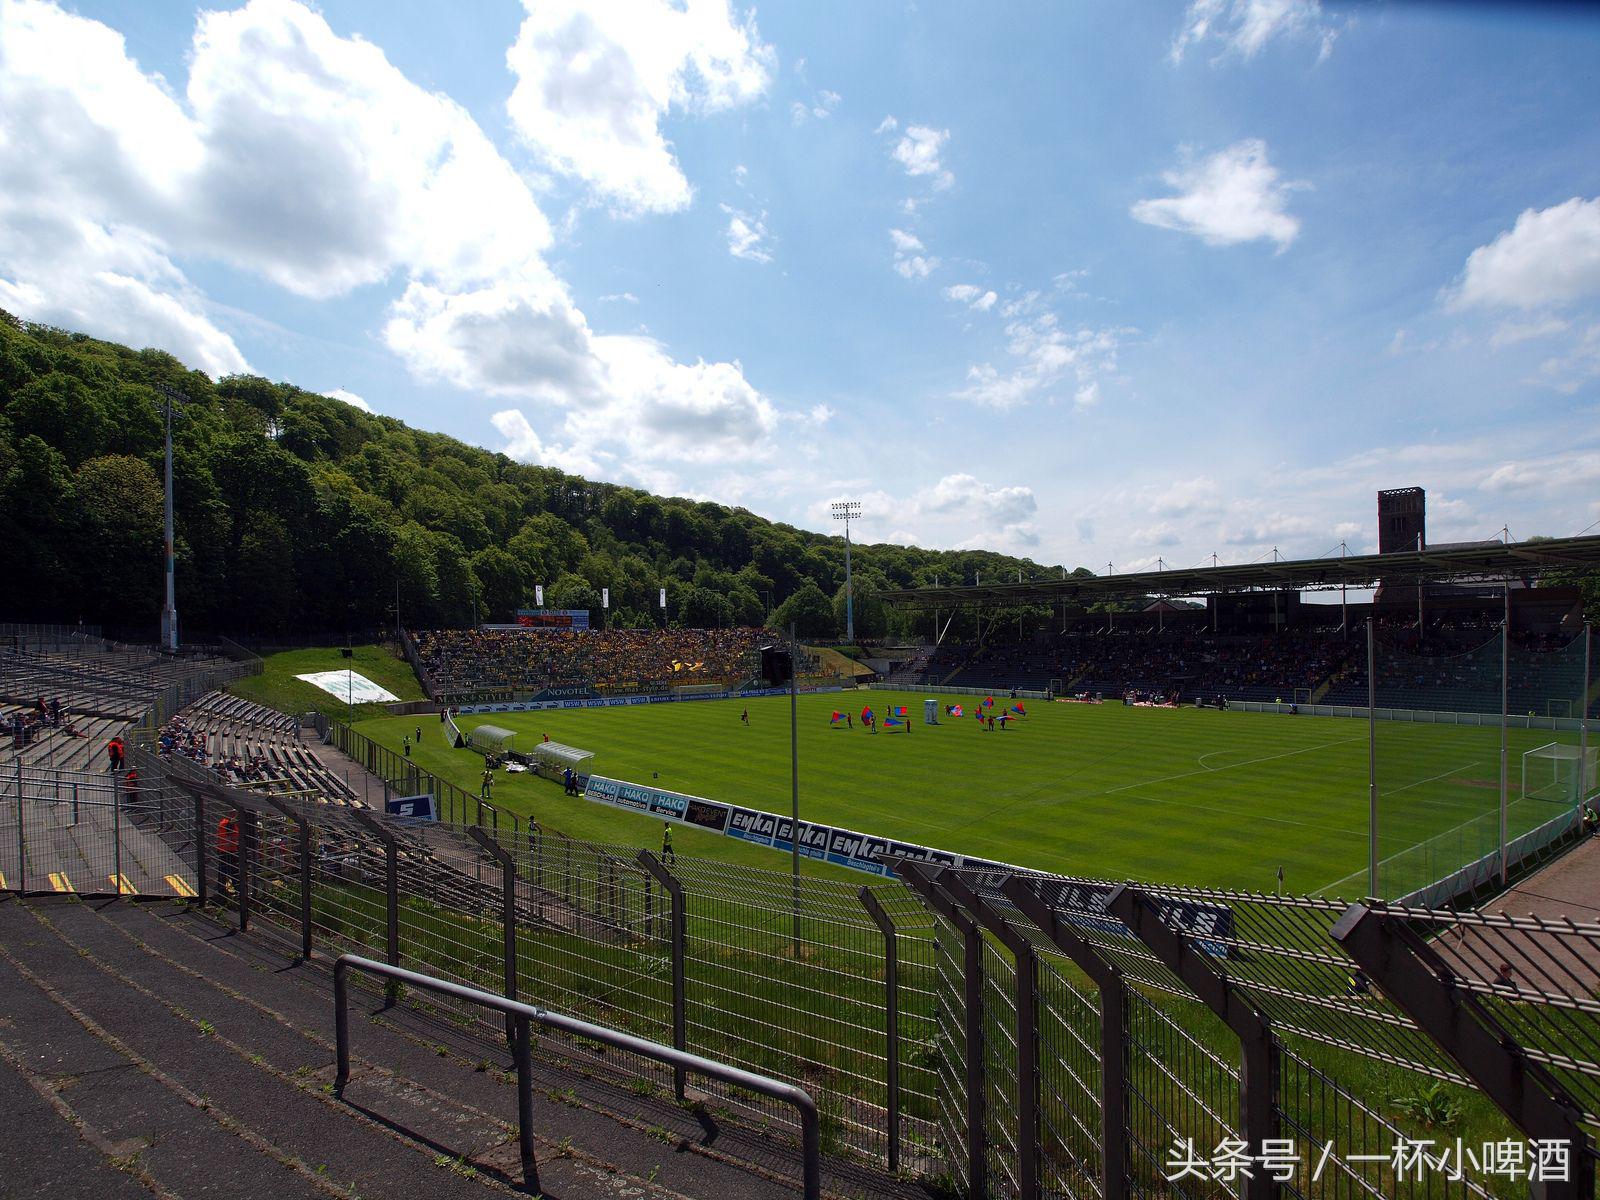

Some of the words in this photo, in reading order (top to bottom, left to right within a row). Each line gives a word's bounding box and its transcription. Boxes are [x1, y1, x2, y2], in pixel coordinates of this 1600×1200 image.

[547, 687, 590, 696] NOVOTEL
[593, 782, 617, 795] HAKO
[624, 789, 649, 802] HAKO
[658, 796, 685, 810] HAKO
[655, 806, 677, 817] Service
[732, 812, 774, 834] EMKA
